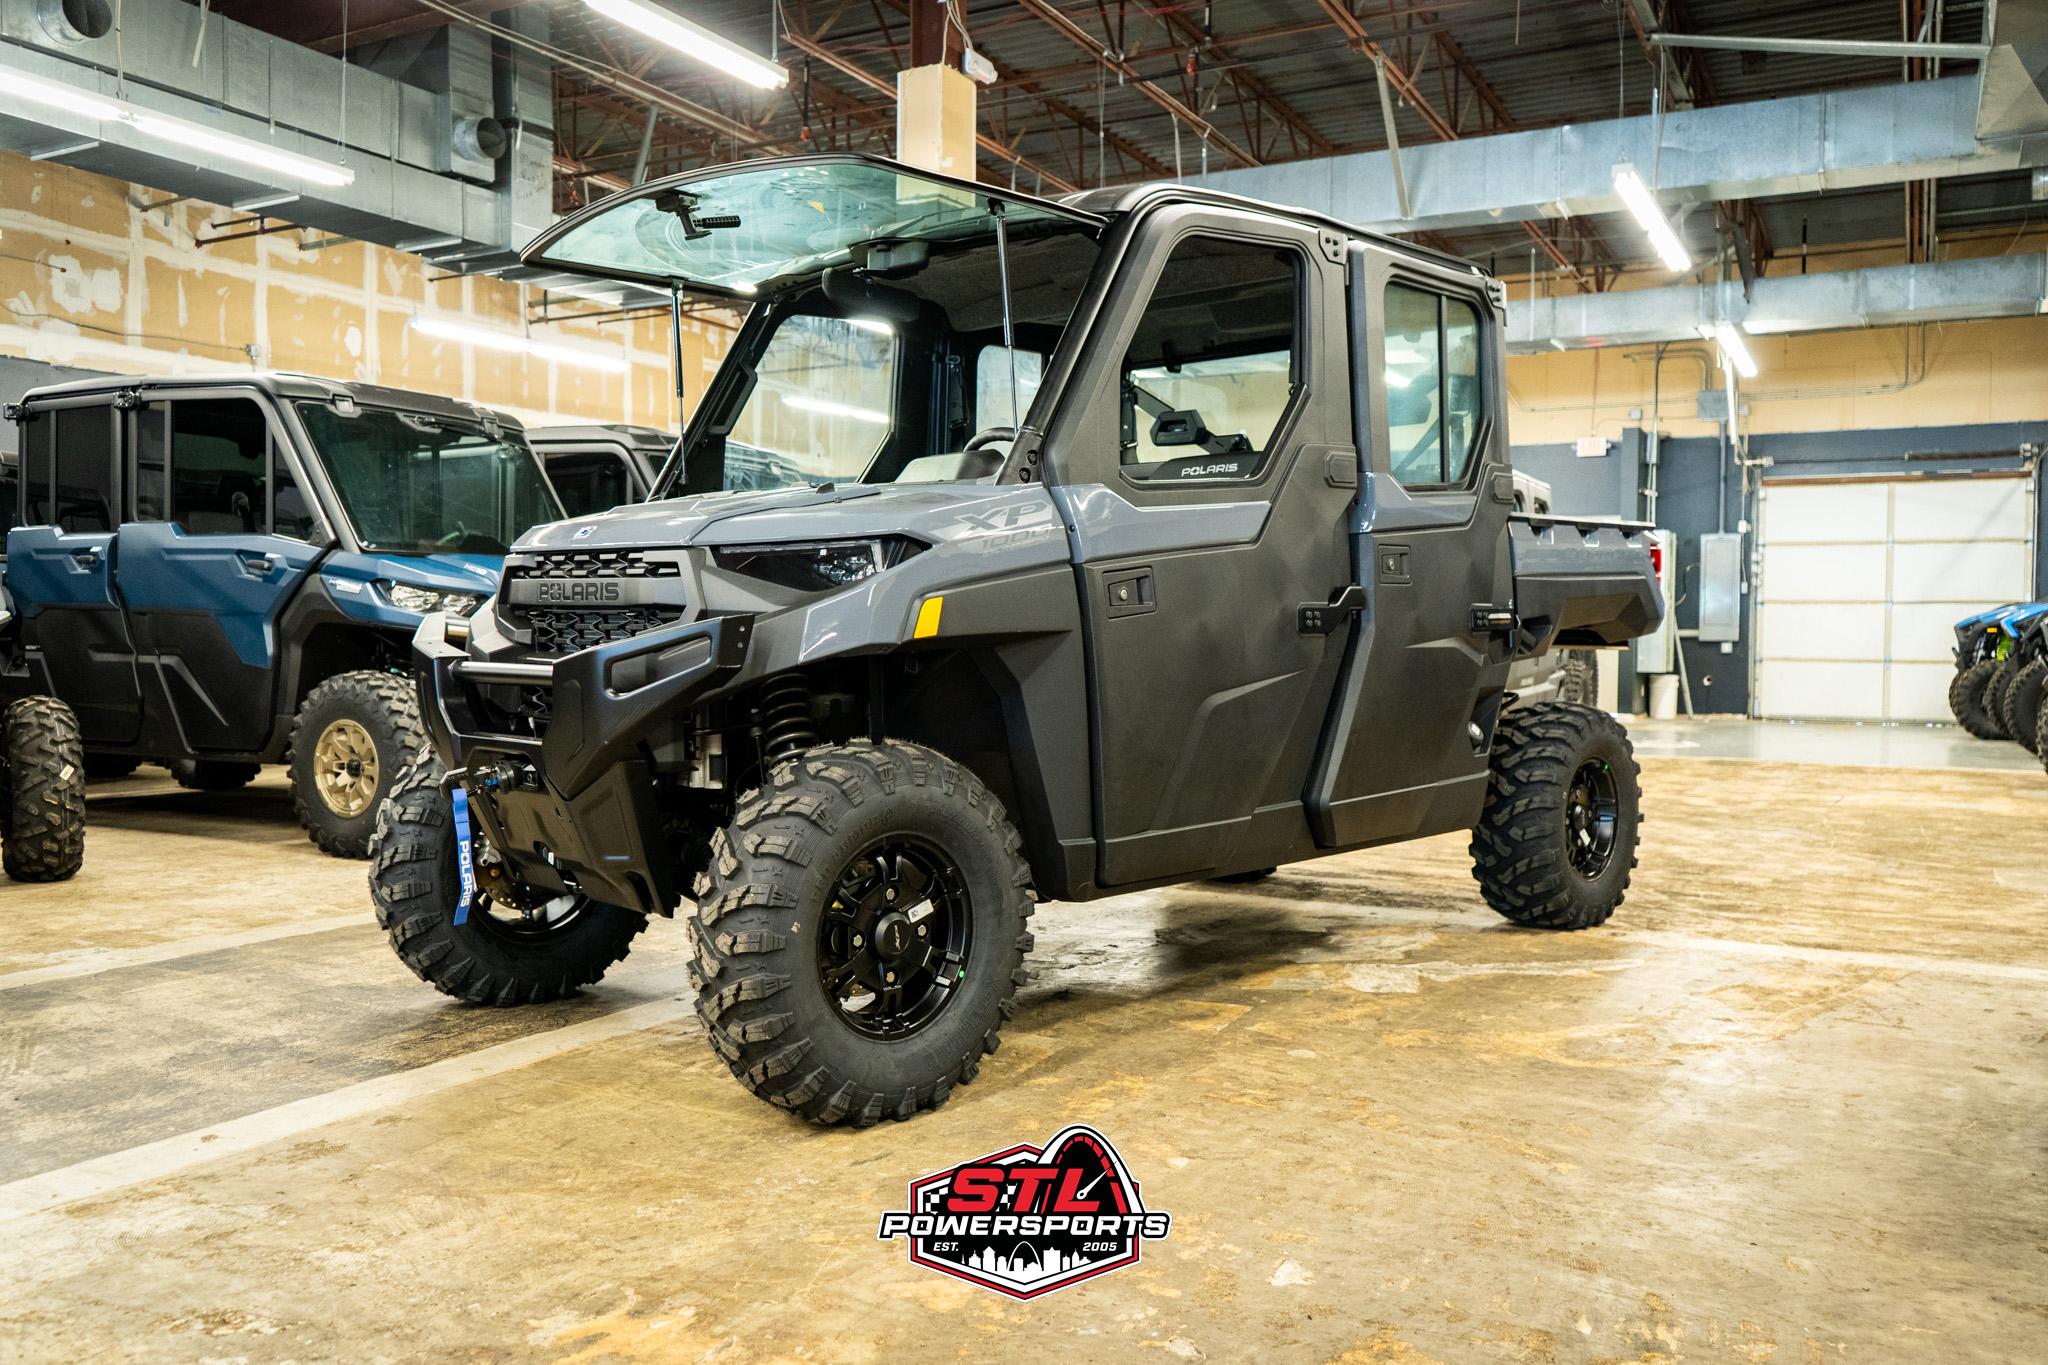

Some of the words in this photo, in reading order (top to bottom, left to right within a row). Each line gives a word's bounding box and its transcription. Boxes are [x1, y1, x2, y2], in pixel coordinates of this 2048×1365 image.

[1181, 463, 1238, 477] POLARIS
[954, 500, 1050, 532] XP
[982, 526, 1051, 549] 1000
[539, 582, 619, 601] POLARIS
[460, 840, 473, 908] POLARIS
